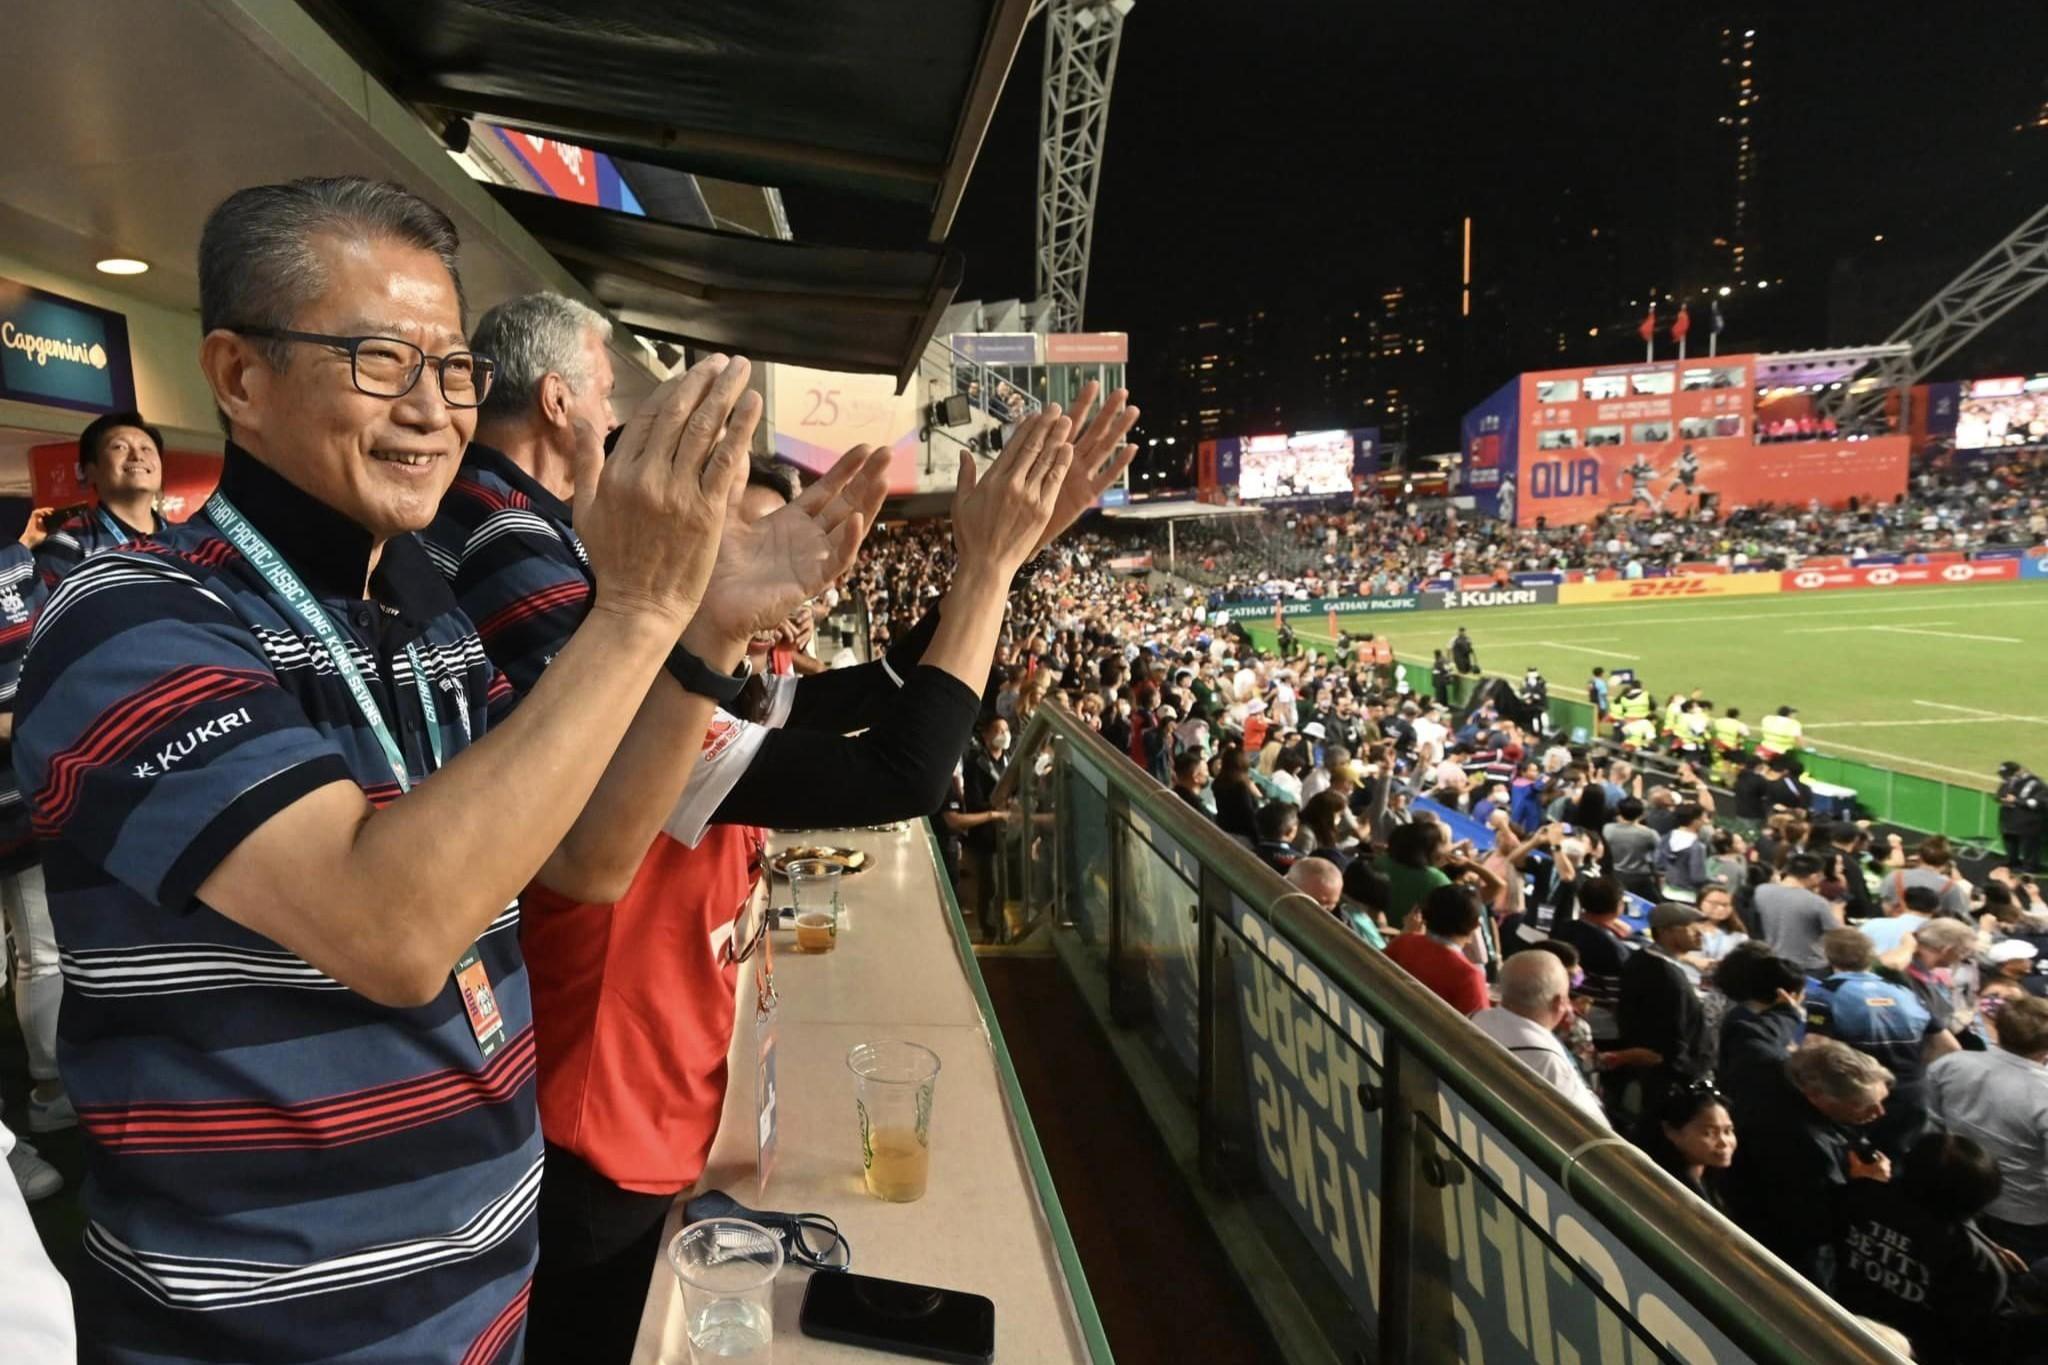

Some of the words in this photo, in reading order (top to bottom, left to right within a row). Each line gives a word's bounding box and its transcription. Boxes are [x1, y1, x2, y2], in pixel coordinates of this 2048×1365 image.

[2, 321, 90, 366] Capgemini
[801, 388, 842, 427] 25
[1531, 458, 1600, 499] OUR
[1323, 600, 1369, 612] CATHAY
[1370, 598, 1416, 609] PACIFIC
[1461, 589, 1537, 607] KUKRI
[1629, 579, 1707, 597] DHL
[295, 599, 332, 636] HONG
[325, 636, 355, 675] KONG
[348, 676, 382, 726] SEVENS
[156, 707, 253, 772] KUKRI
[1869, 1219, 1912, 1253] THE
[1848, 1250, 1926, 1303] FORD
